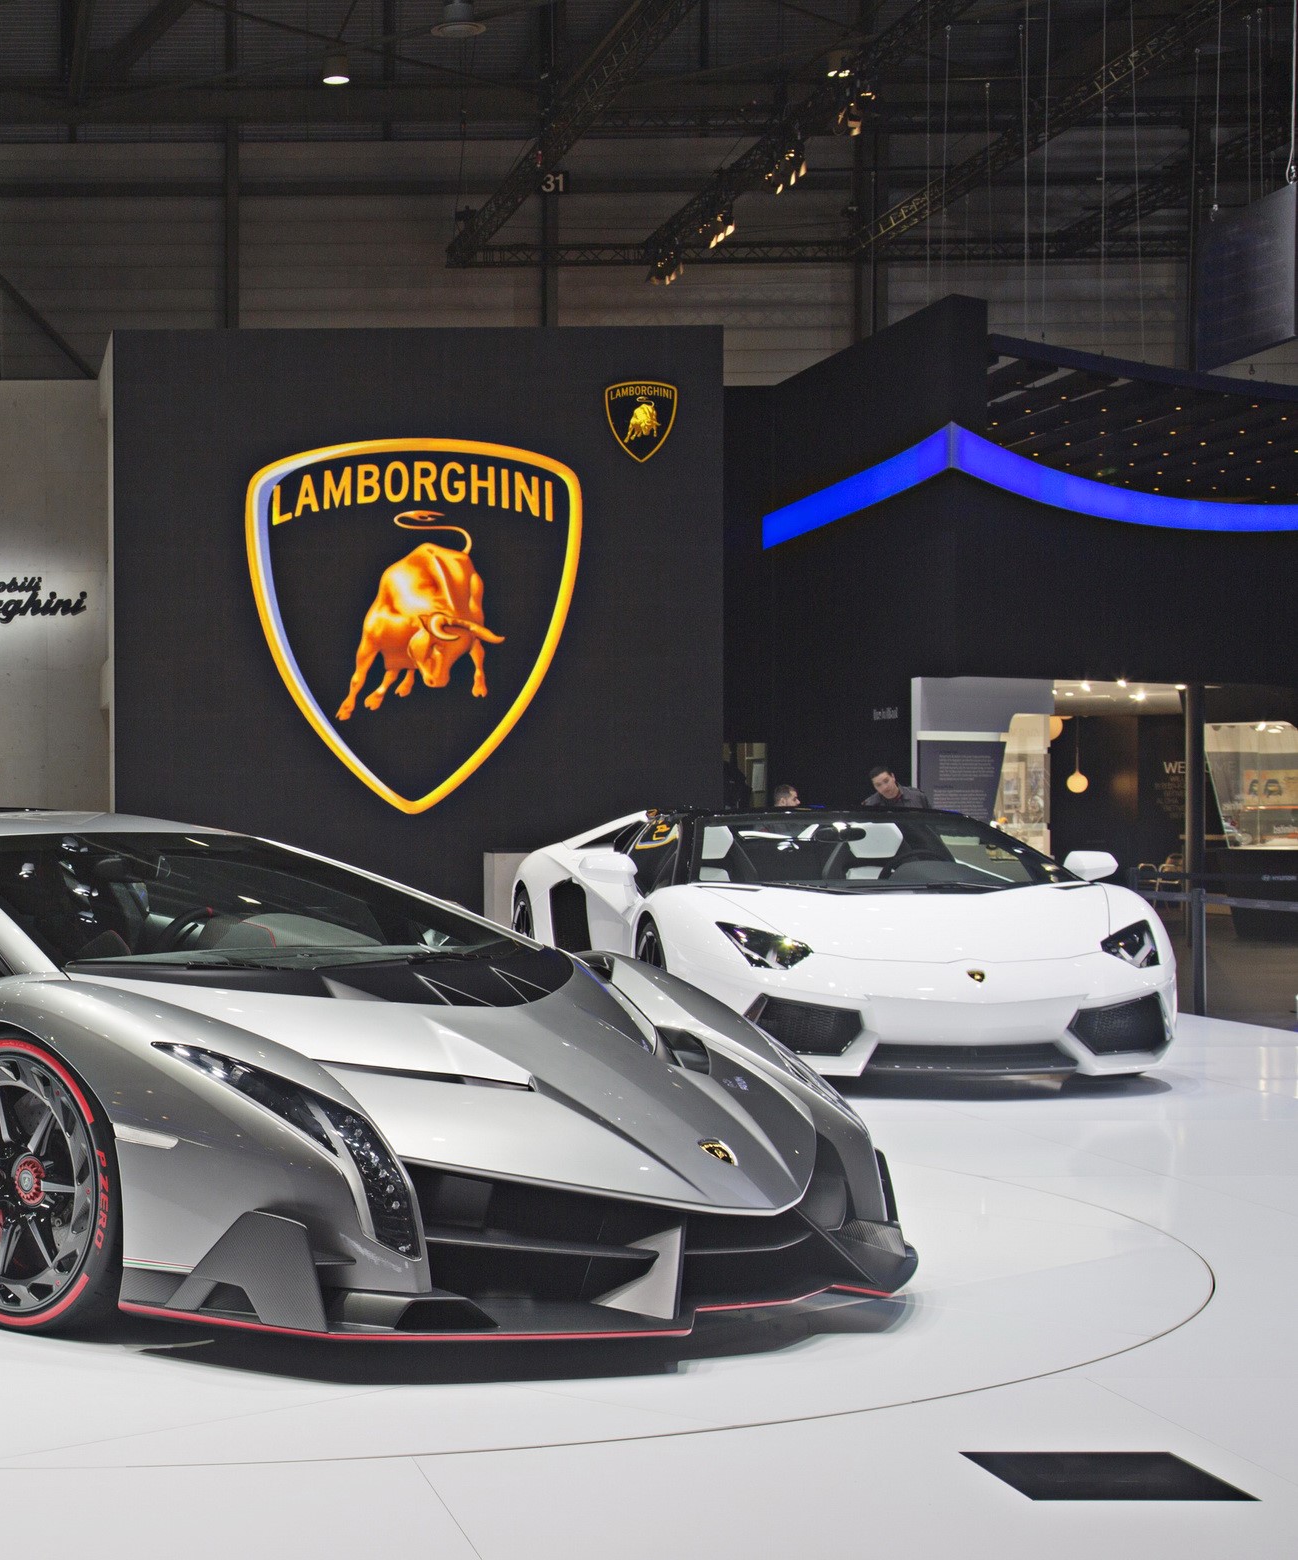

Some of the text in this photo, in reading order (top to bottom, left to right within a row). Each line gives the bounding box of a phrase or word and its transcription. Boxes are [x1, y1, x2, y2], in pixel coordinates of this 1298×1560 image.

[542, 174, 564, 192] 31
[610, 386, 672, 400] LAMBORGHINI
[272, 461, 553, 526] LAMBORGHINI
[94, 1149, 109, 1250] P ZERO
